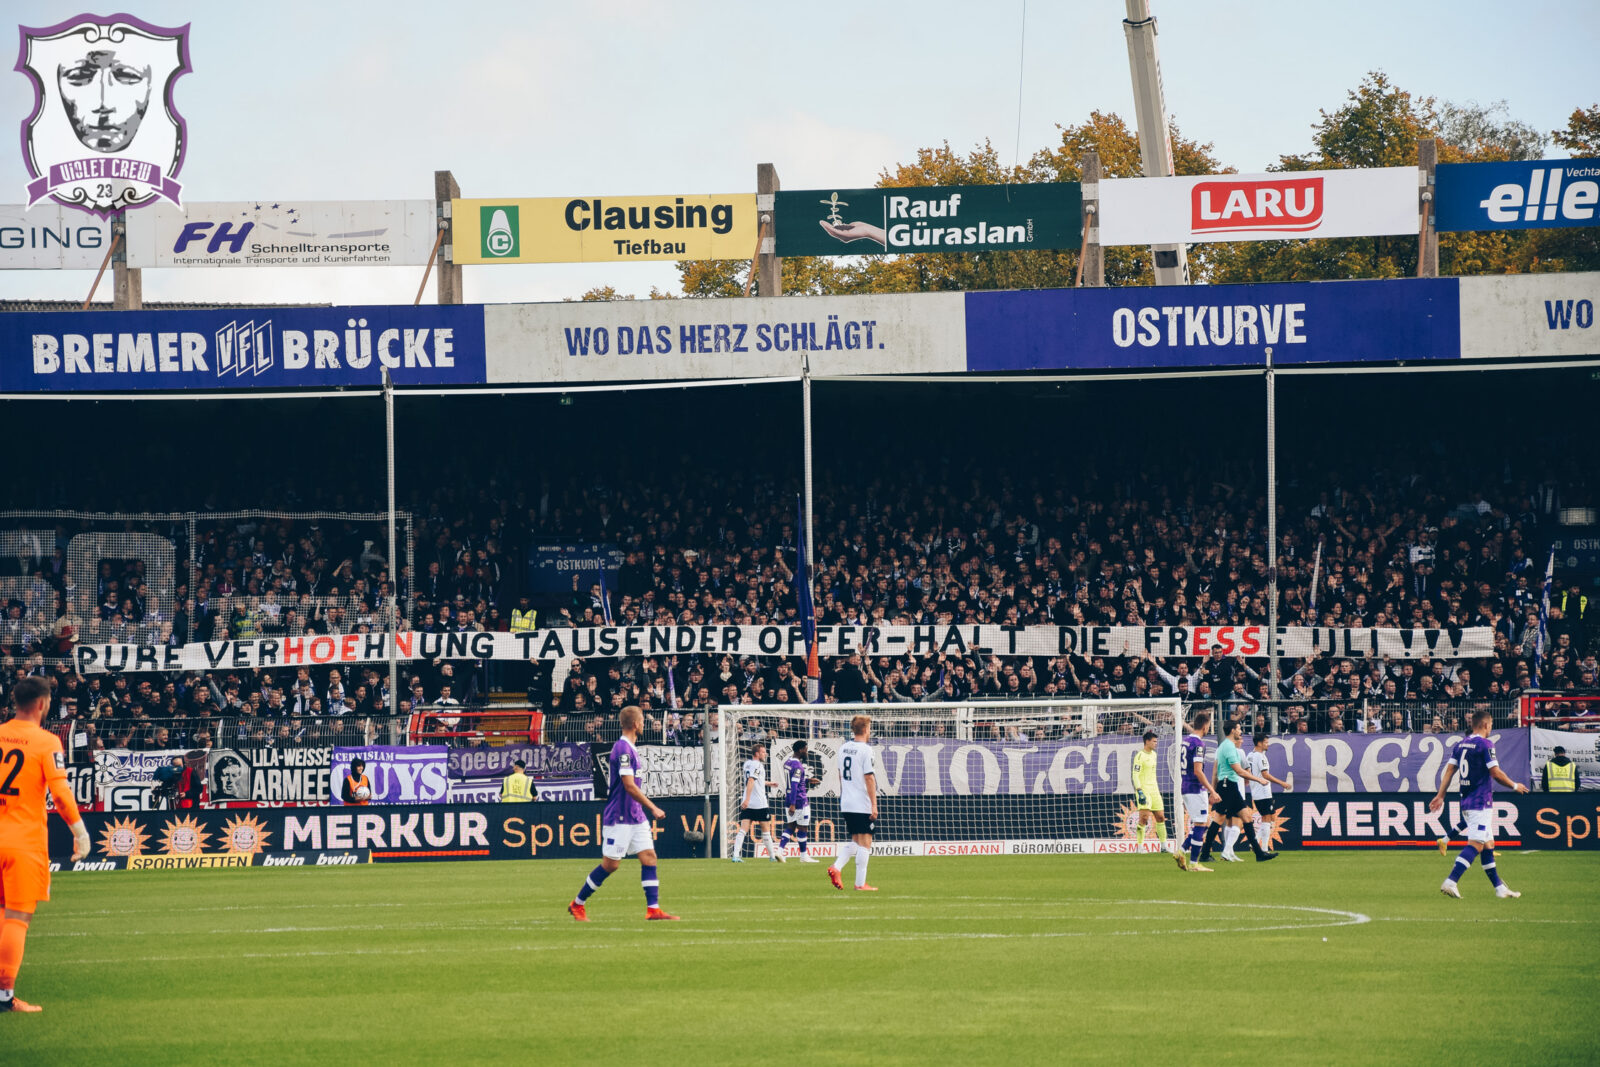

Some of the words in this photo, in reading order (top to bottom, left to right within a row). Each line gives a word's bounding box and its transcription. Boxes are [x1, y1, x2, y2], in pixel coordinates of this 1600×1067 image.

[565, 197, 733, 234] Clausing
[889, 194, 961, 219] Rauf
[1200, 187, 1316, 221] LARU
[0, 226, 102, 250] GING
[173, 221, 255, 254] FH
[888, 221, 1026, 247] Güraslan
[173, 256, 242, 265] Internationale
[244, 256, 298, 265] Transporte
[302, 255, 321, 264] und
[323, 254, 391, 264] Kurierfahrten
[251, 242, 391, 255] Schnelltransporte
[613, 239, 686, 255] Tiefbau
[1112, 303, 1307, 348] OSTKURVE
[1545, 298, 1594, 330] WO
[32, 332, 210, 375] BREMER
[283, 318, 455, 371] BRÜCKE
[564, 326, 610, 357] WO
[617, 325, 673, 356] DAS
[679, 323, 749, 354] HERZ
[756, 314, 885, 352] SCHLÄGT.
[77, 644, 184, 674] PURE
[203, 631, 495, 669] VERHOEHNUNG
[515, 625, 742, 660] TAUSENDER
[1059, 626, 1111, 656] DIE
[1143, 626, 1286, 656] FRESSE
[252, 747, 331, 767] LILA-WEISSE
[842, 756, 852, 781] 8
[1459, 749, 1469, 779] 6
[252, 768, 331, 801] ARMEE
[283, 811, 490, 851] MERKUR
[502, 813, 602, 856] Spiel
[263, 853, 304, 867] bwin
[316, 852, 358, 865] bwin
[761, 846, 832, 857] ASMNN
[928, 845, 1000, 855] ASSMANN
[1012, 842, 1085, 854] BÜROMÖBEL
[1098, 843, 1171, 853] ASSMAN
[72, 857, 116, 872] bwin
[132, 856, 248, 870] SPORTWETTEN
